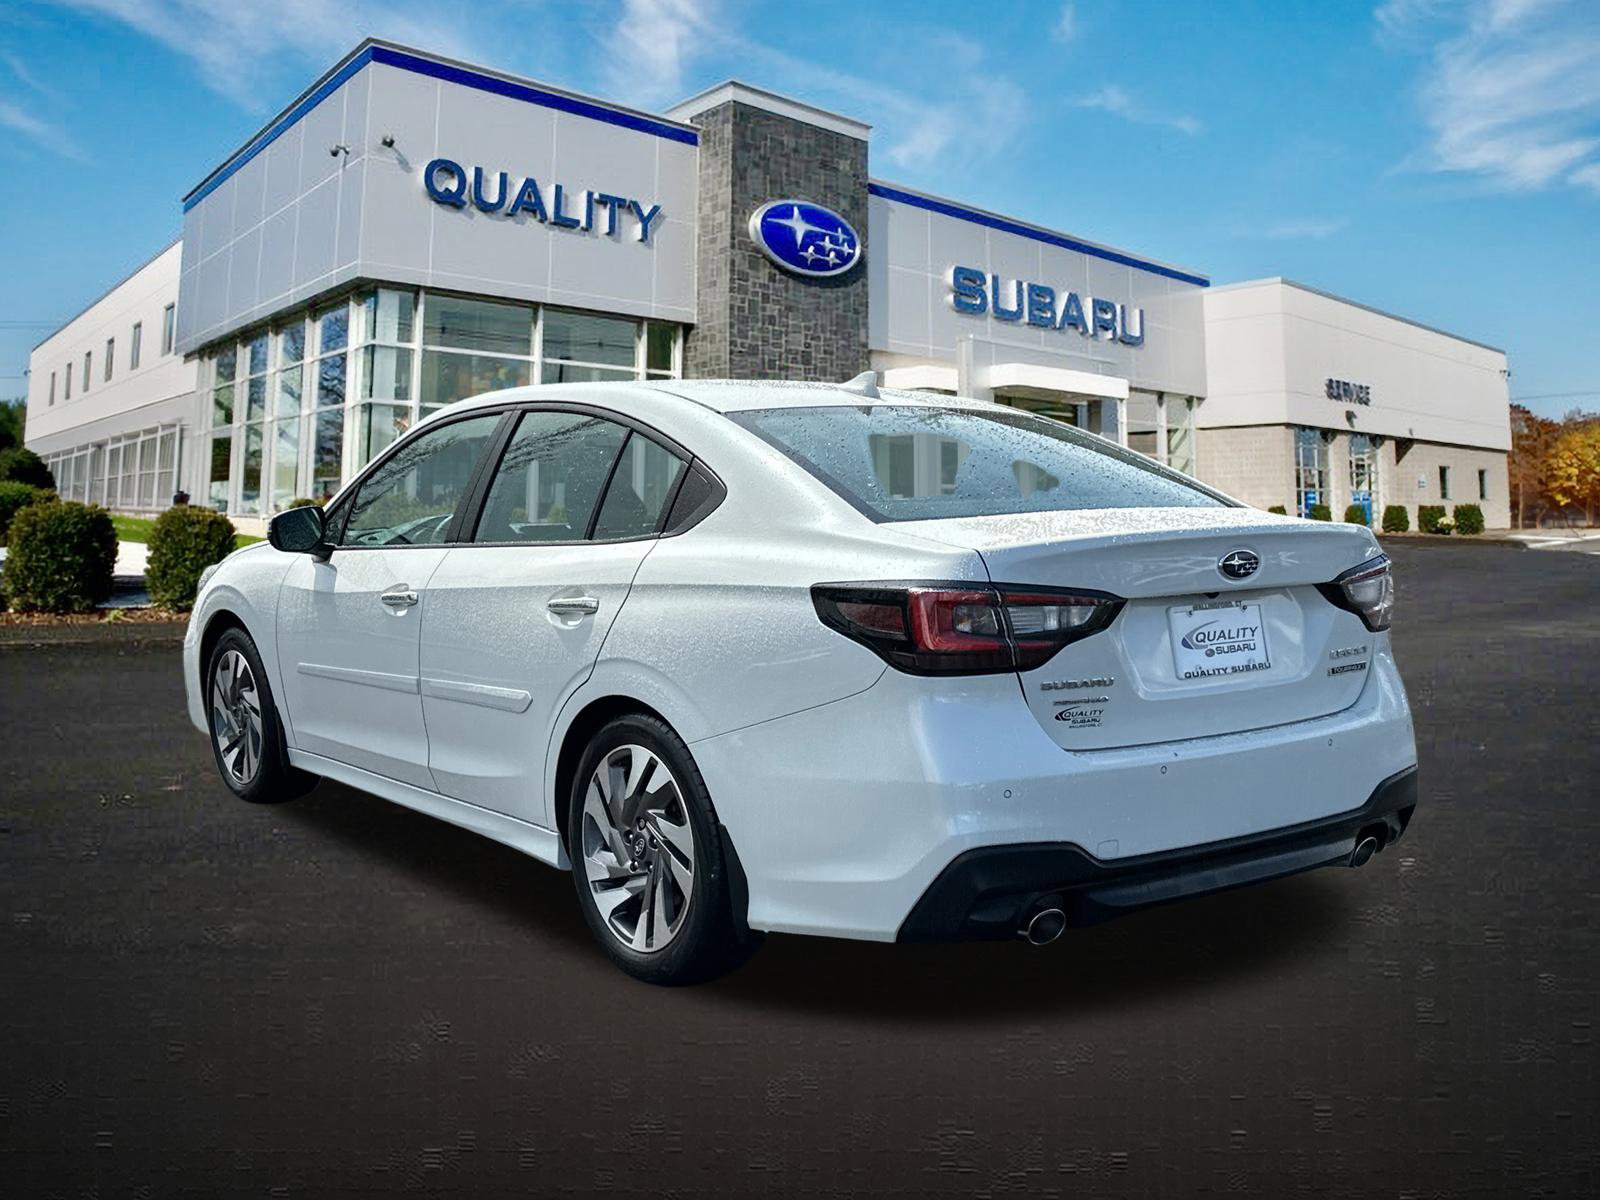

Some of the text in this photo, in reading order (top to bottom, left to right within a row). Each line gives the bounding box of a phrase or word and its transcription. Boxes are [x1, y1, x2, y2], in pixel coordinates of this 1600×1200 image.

[424, 158, 662, 243] QUALITY
[950, 265, 1145, 346] SUBARU
[1325, 378, 1371, 406] SERVICE
[1195, 626, 1258, 643] QUALITY
[1215, 643, 1256, 655] SUBARU
[1184, 662, 1272, 679] QUALITY SUBARU
[1040, 677, 1115, 691] SUBARU
[1064, 709, 1104, 718] QUALITY
